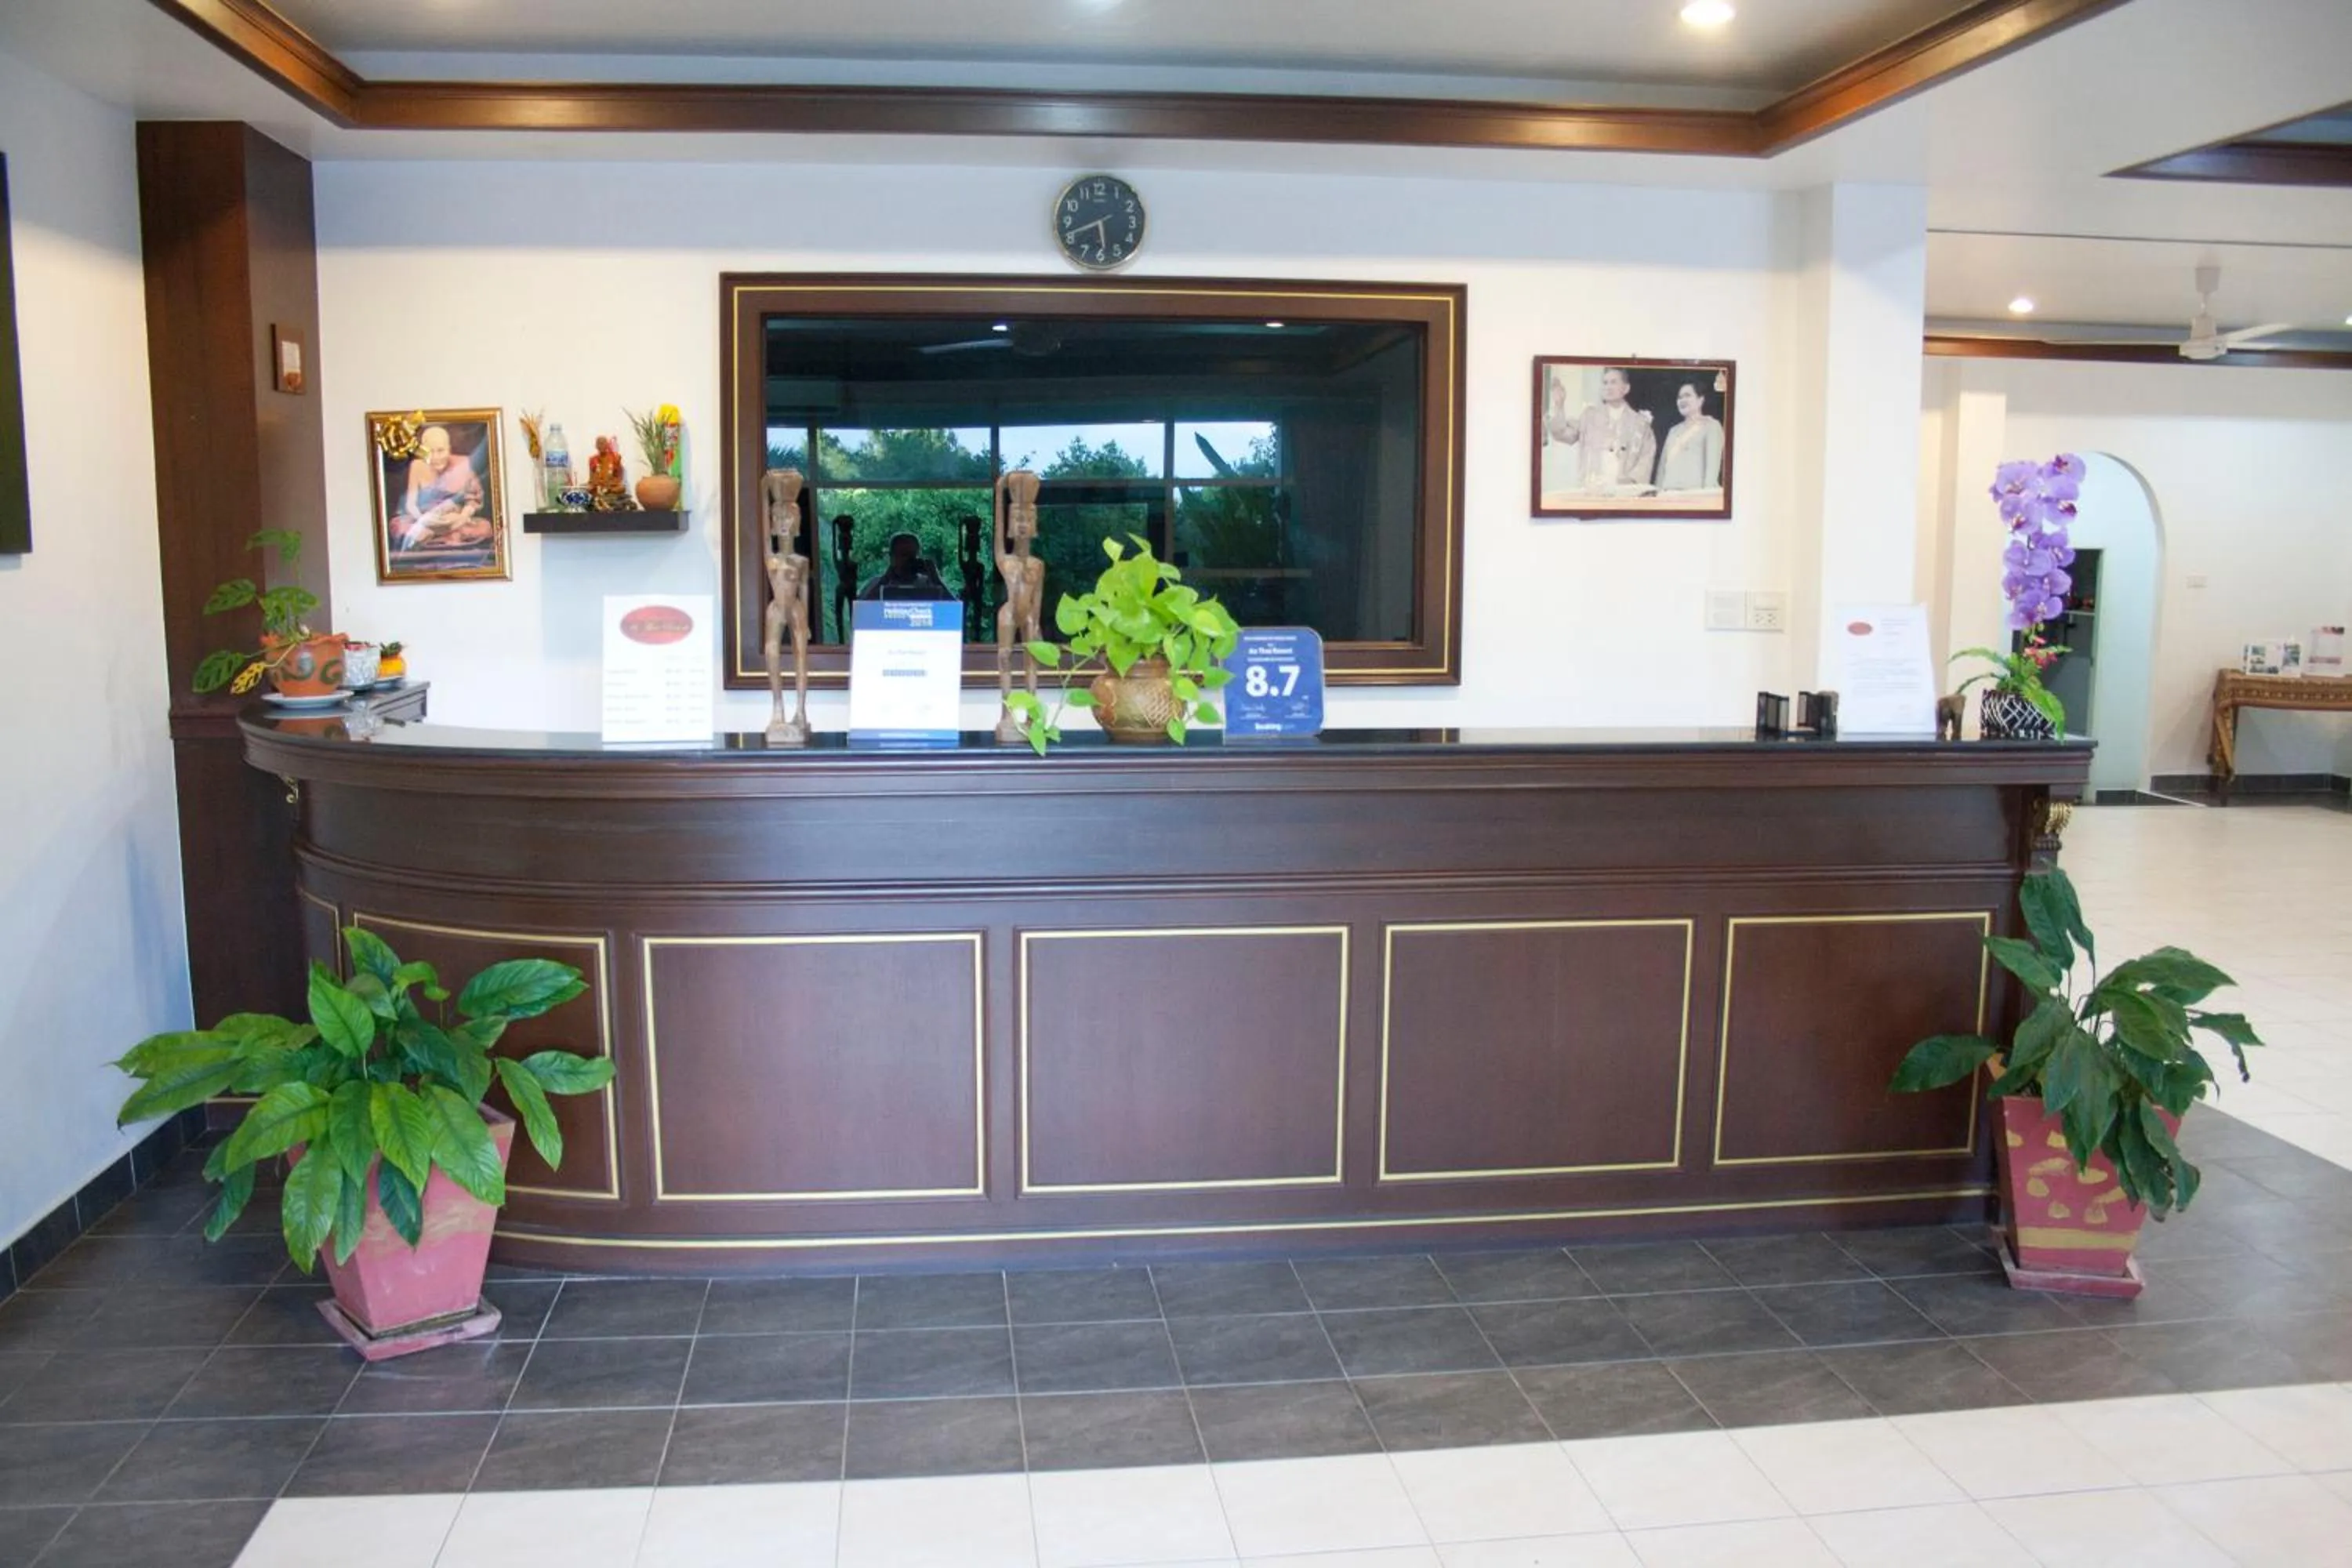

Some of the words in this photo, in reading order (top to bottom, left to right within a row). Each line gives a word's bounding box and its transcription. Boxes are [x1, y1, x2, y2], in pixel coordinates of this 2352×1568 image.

[1080, 187, 1089, 200] 11
[1093, 183, 1106, 196] 12
[1114, 187, 1119, 199] 1
[1067, 200, 1078, 212] 10
[1126, 200, 1134, 212] 2
[1063, 216, 1072, 228] 9
[1128, 216, 1136, 228] 3
[1066, 232, 1075, 245] 8
[1124, 233, 1133, 243] 4
[1080, 244, 1089, 258] 7
[1096, 249, 1105, 261] 6
[1113, 244, 1122, 257] 5
[1246, 665, 1301, 697] 8.7
